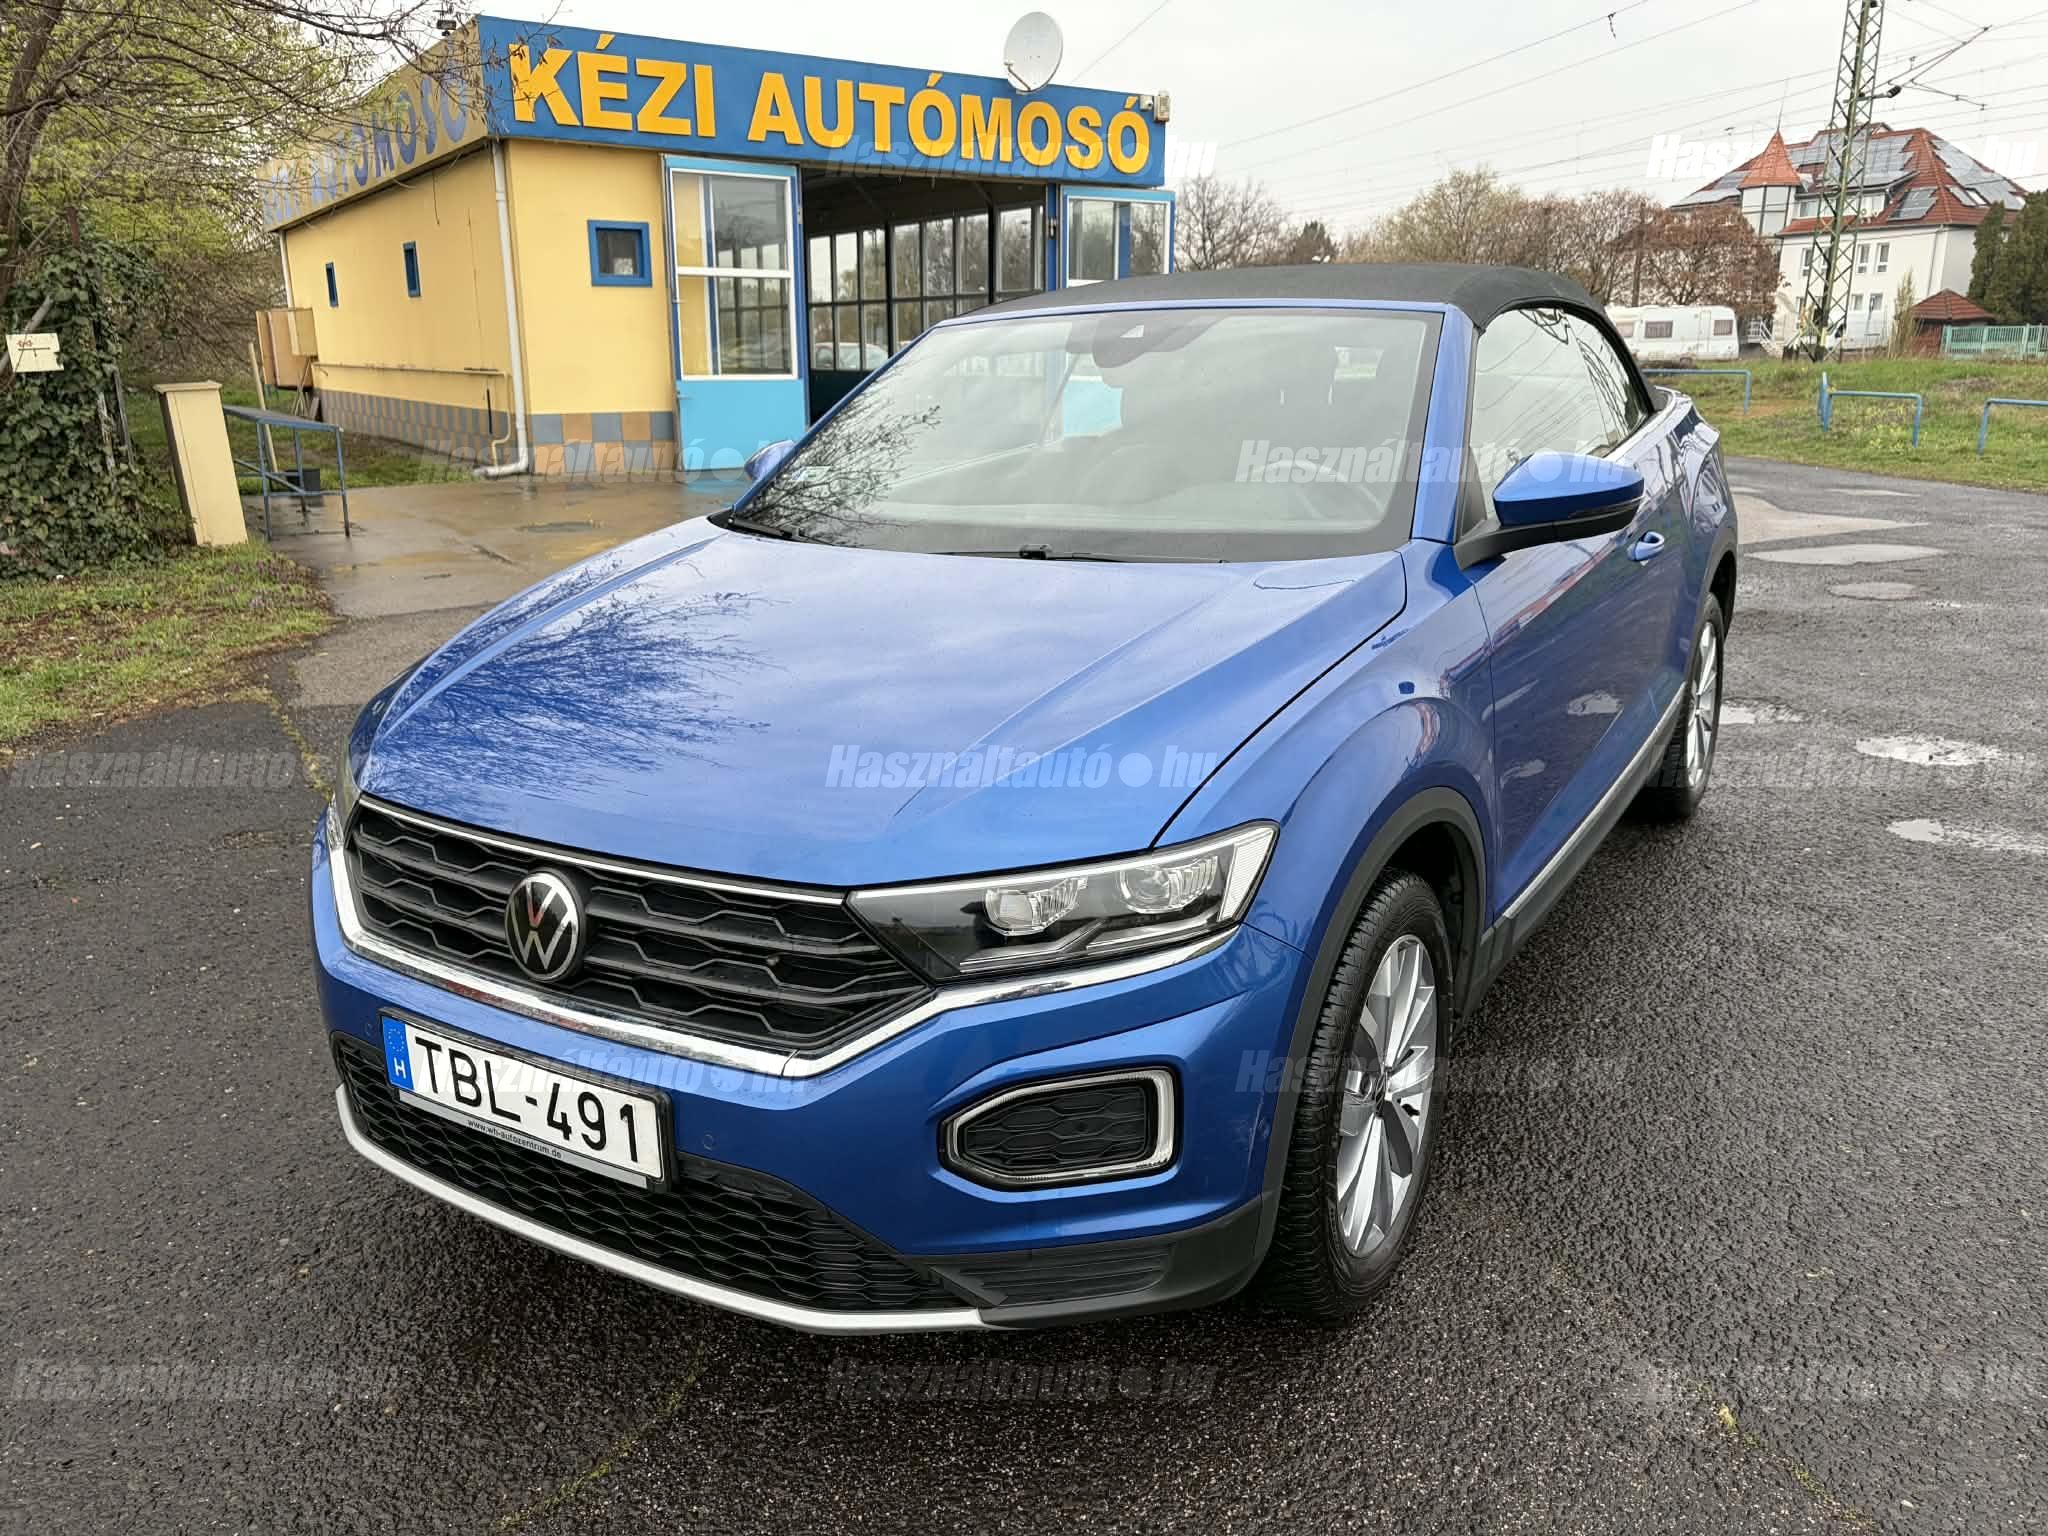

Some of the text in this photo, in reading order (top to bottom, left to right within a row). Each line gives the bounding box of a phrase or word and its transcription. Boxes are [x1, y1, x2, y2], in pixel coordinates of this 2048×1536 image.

[508, 33, 1150, 174] KÉZI AUTÓMOSÓ
[414, 1036, 638, 1163] TBL-491
